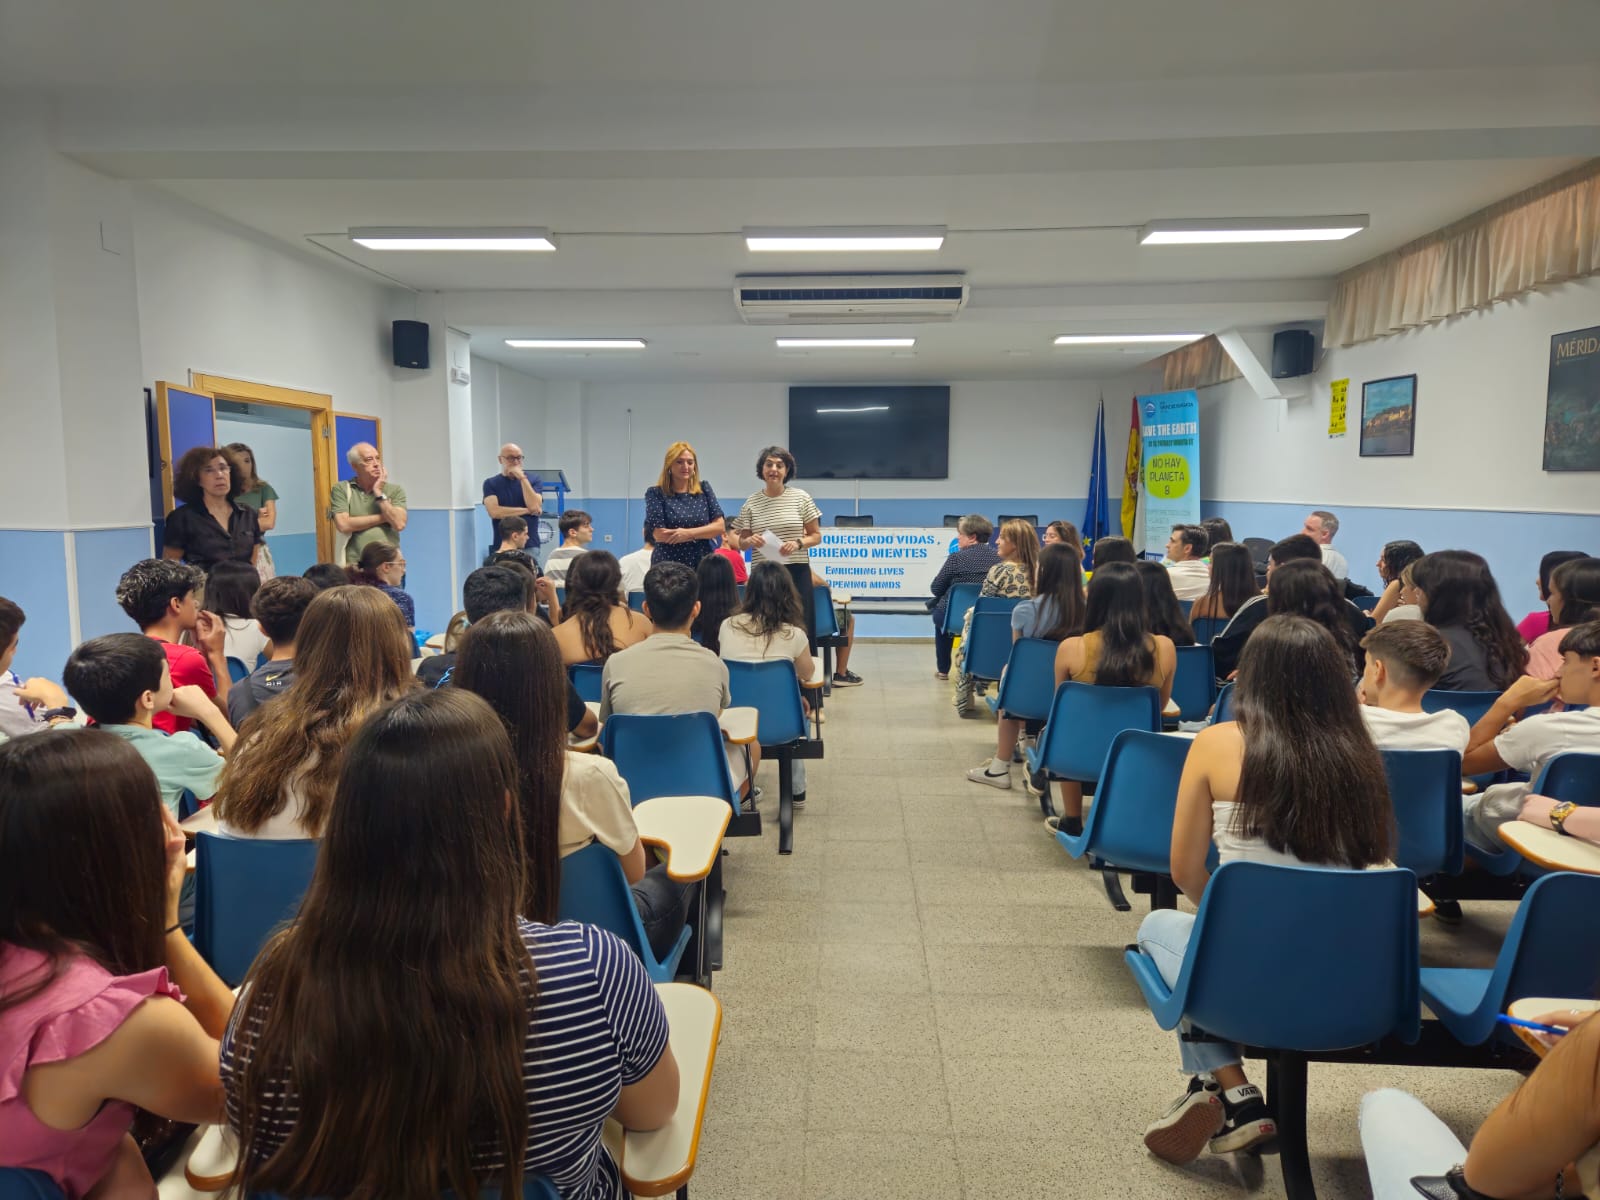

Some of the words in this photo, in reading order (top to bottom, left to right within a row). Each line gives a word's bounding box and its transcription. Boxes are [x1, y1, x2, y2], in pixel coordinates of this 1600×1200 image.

[1557, 337, 1600, 359] MÉRID
[1157, 424, 1170, 436] THE
[1172, 422, 1197, 435] EARTH
[1152, 458, 1163, 469] NO
[1164, 457, 1181, 468] HAY
[1149, 471, 1185, 482] PLANETA
[822, 535, 893, 545] QUECIENDO
[808, 547, 868, 558] BRIENDO
[871, 548, 928, 558] MENTES
[878, 567, 905, 575] LIVES
[869, 581, 901, 589] MINDS
